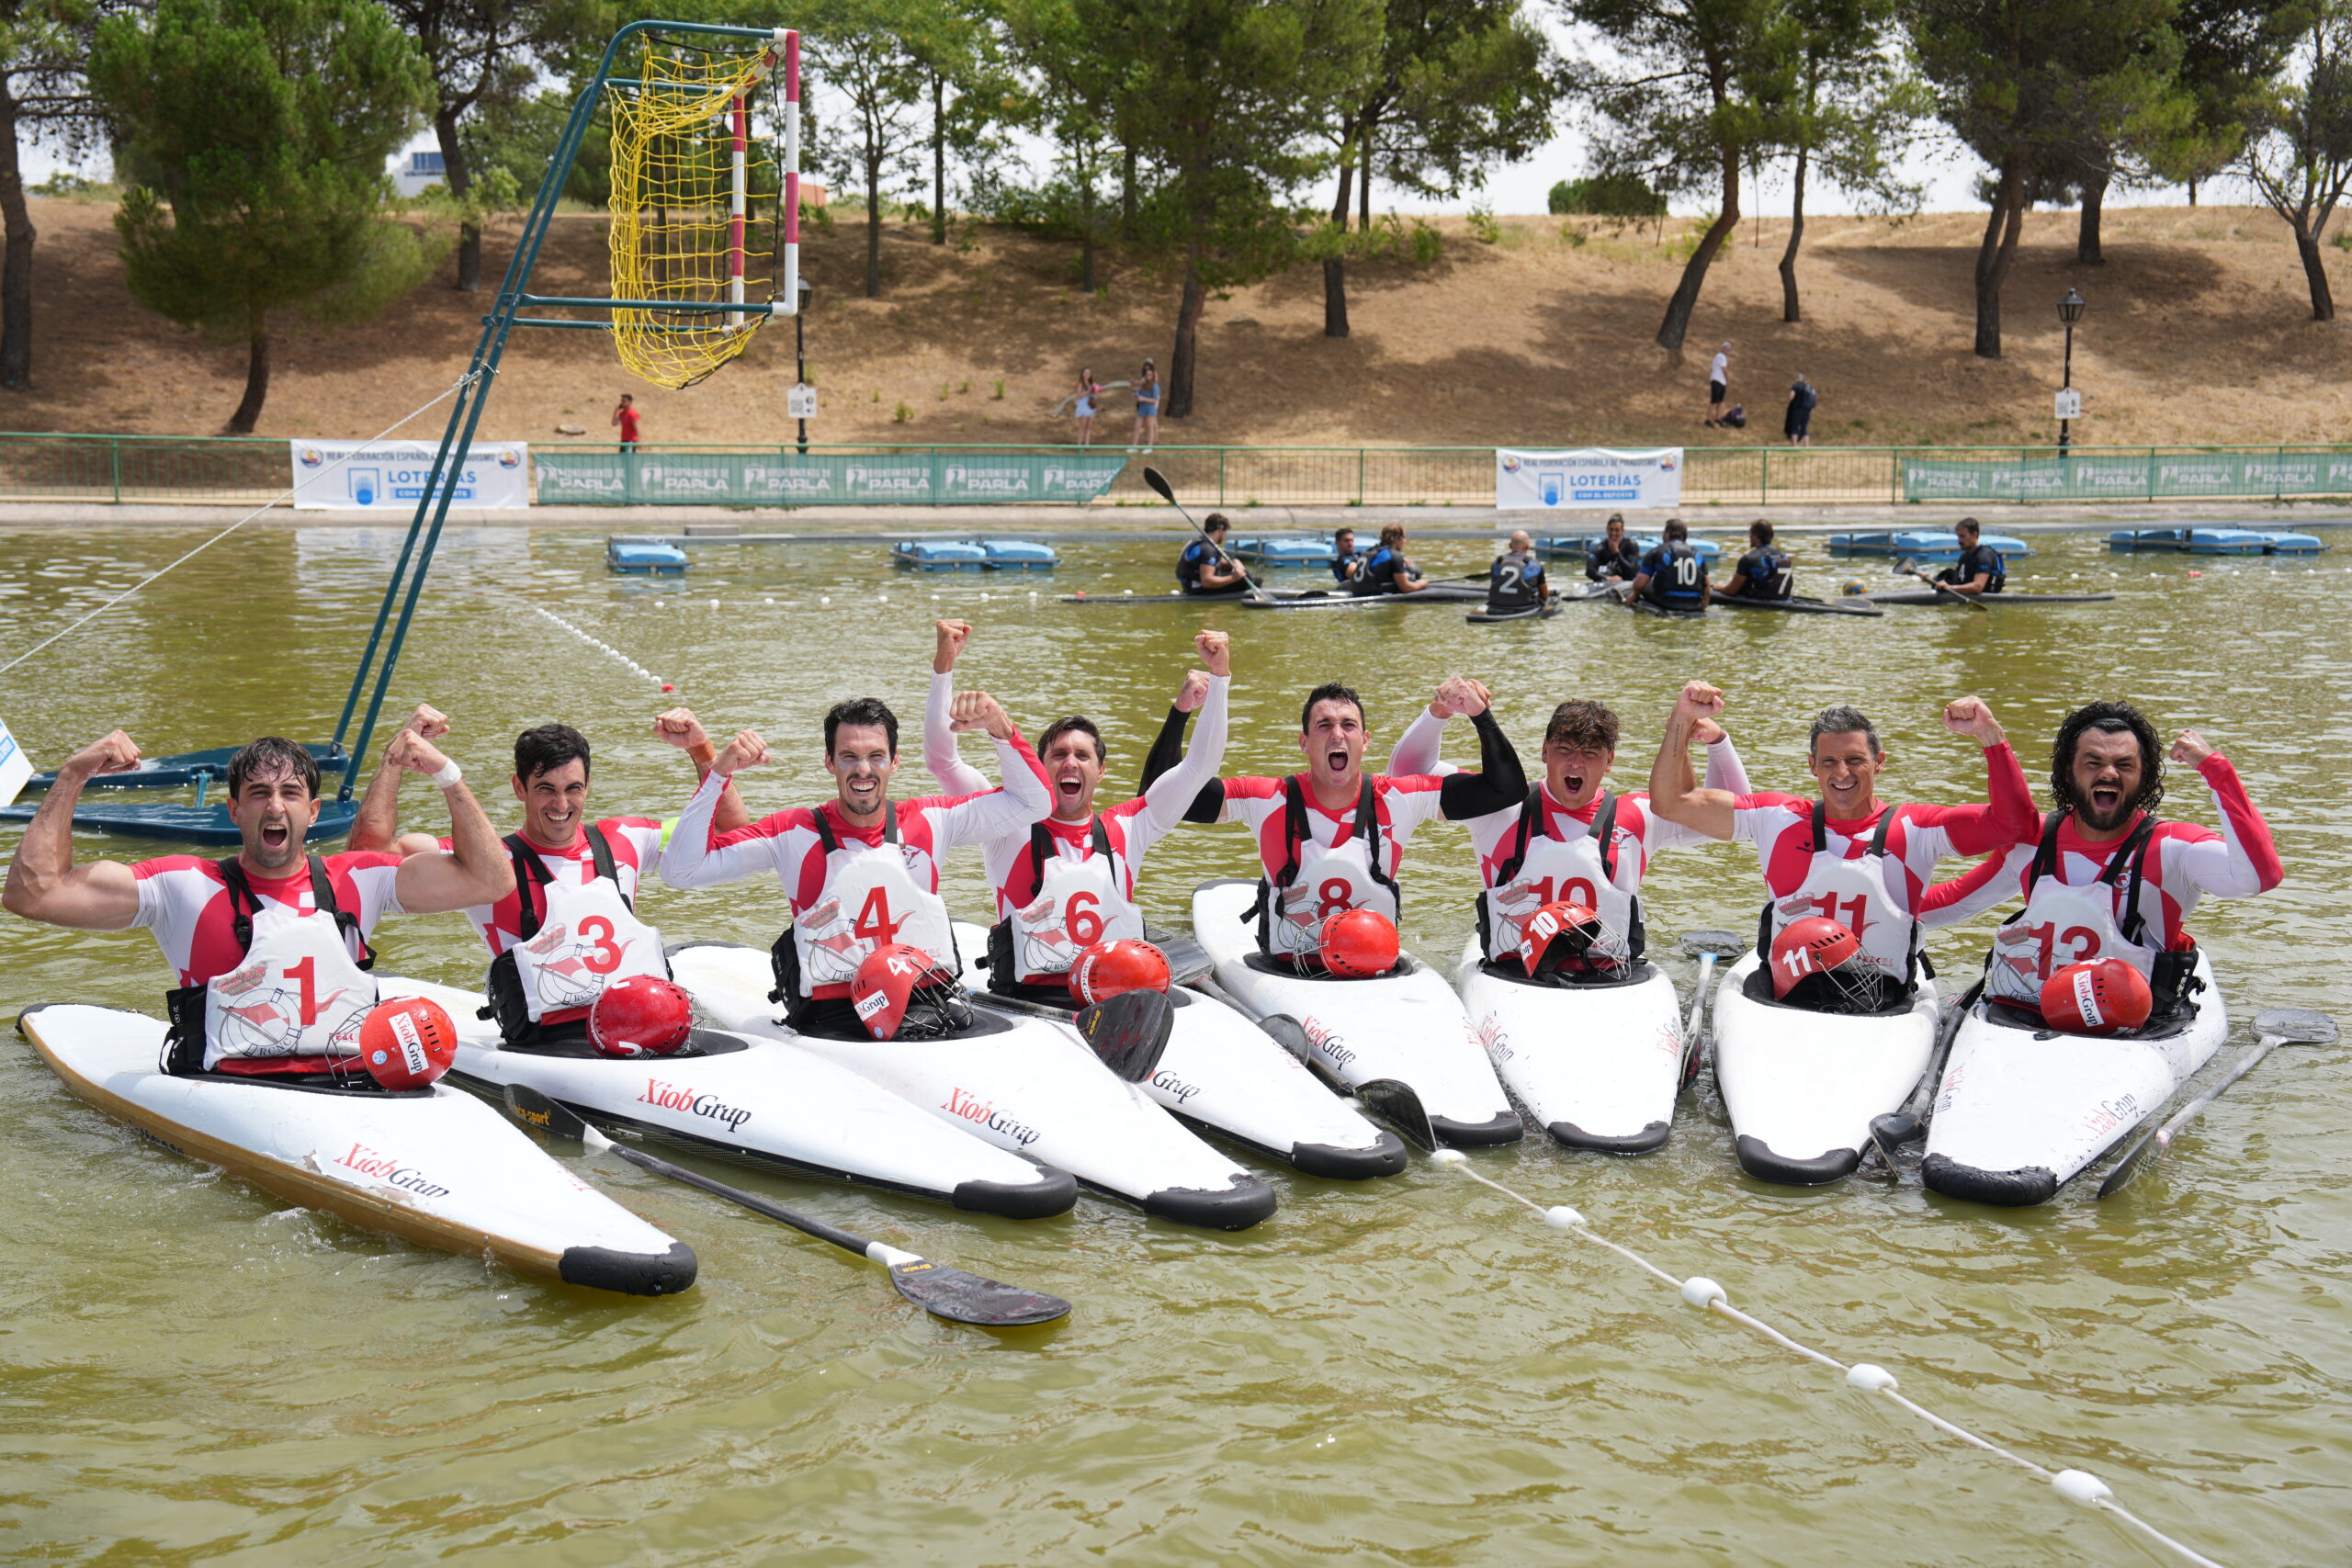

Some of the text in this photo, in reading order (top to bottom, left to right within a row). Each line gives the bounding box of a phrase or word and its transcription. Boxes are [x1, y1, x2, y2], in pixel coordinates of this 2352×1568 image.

[388, 470, 477, 483] LOTERAS
[560, 479, 625, 490] PARLA
[664, 479, 729, 490] PARLA
[767, 479, 831, 490] PARLA
[868, 479, 930, 490] PARLA
[967, 479, 1029, 490] PARLA
[1570, 473, 1642, 486] LOTERÍAS
[1928, 478, 1979, 489] PARLA
[2011, 477, 2063, 488] PARLA
[2096, 475, 2147, 486] PARLA
[2179, 473, 2231, 484] PARLA
[2263, 473, 2315, 483] PARLA
[1353, 556, 1368, 582] 3
[1499, 566, 1519, 594] 2
[1674, 558, 1697, 585] 10
[1777, 568, 1792, 594] 7
[1317, 878, 1352, 919] 8
[1527, 875, 1597, 916] 10
[854, 886, 899, 946] 4
[1066, 891, 1103, 946] 6
[1529, 910, 1559, 941] 10
[1811, 891, 1867, 942] 11
[577, 915, 622, 974] 3
[2028, 920, 2101, 981] 13
[887, 956, 913, 976] 4
[1782, 946, 1813, 977] 11
[283, 956, 316, 1026] 1
[2077, 973, 2098, 1026] XiobGrup
[260, 1036, 293, 1056] RCNC
[393, 1013, 424, 1073] XiobGrup
[638, 1078, 752, 1133] XiobGrup
[940, 1087, 1041, 1149] XiobGrup
